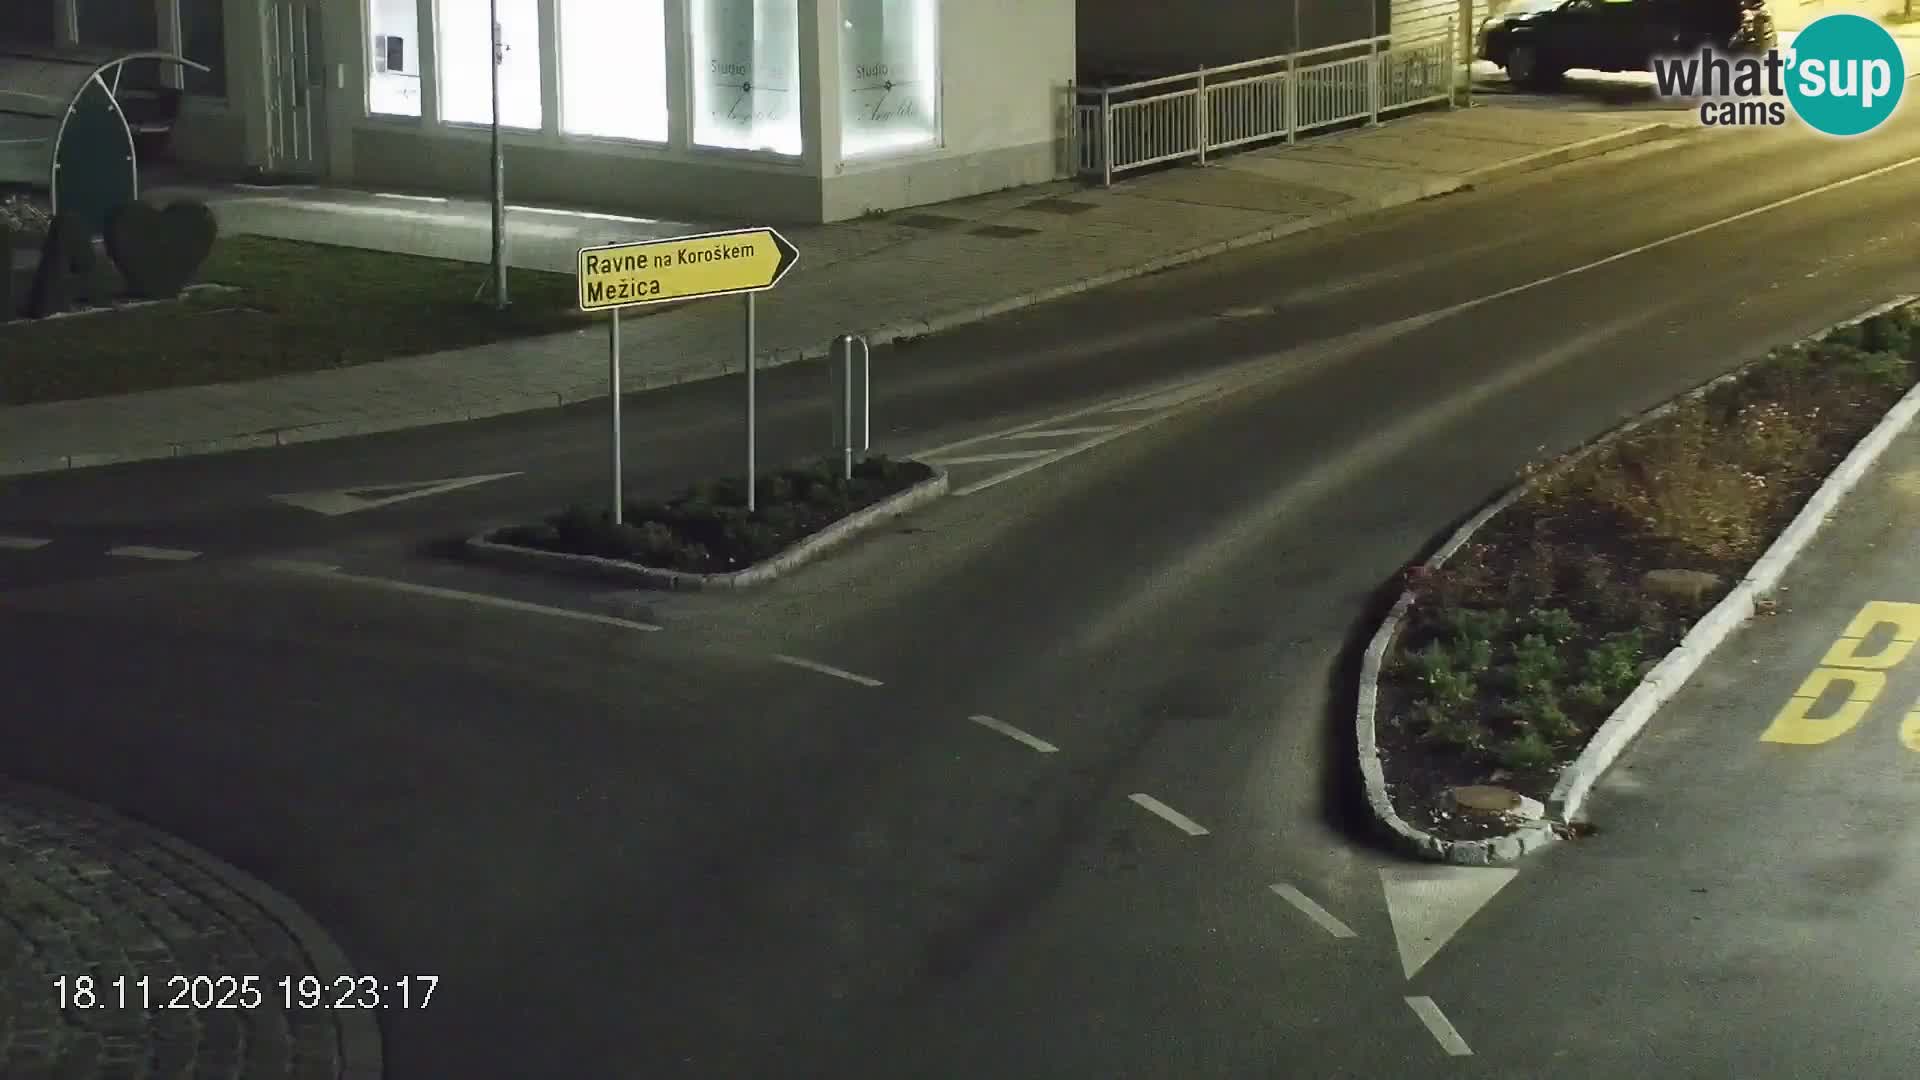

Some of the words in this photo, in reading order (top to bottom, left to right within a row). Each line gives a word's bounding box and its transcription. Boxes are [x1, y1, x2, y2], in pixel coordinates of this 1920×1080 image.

[856, 63, 889, 80] Studio
[586, 254, 648, 275] Ravne
[654, 254, 672, 268] na
[678, 244, 755, 265] Koroškem
[586, 278, 661, 302] Mežica
